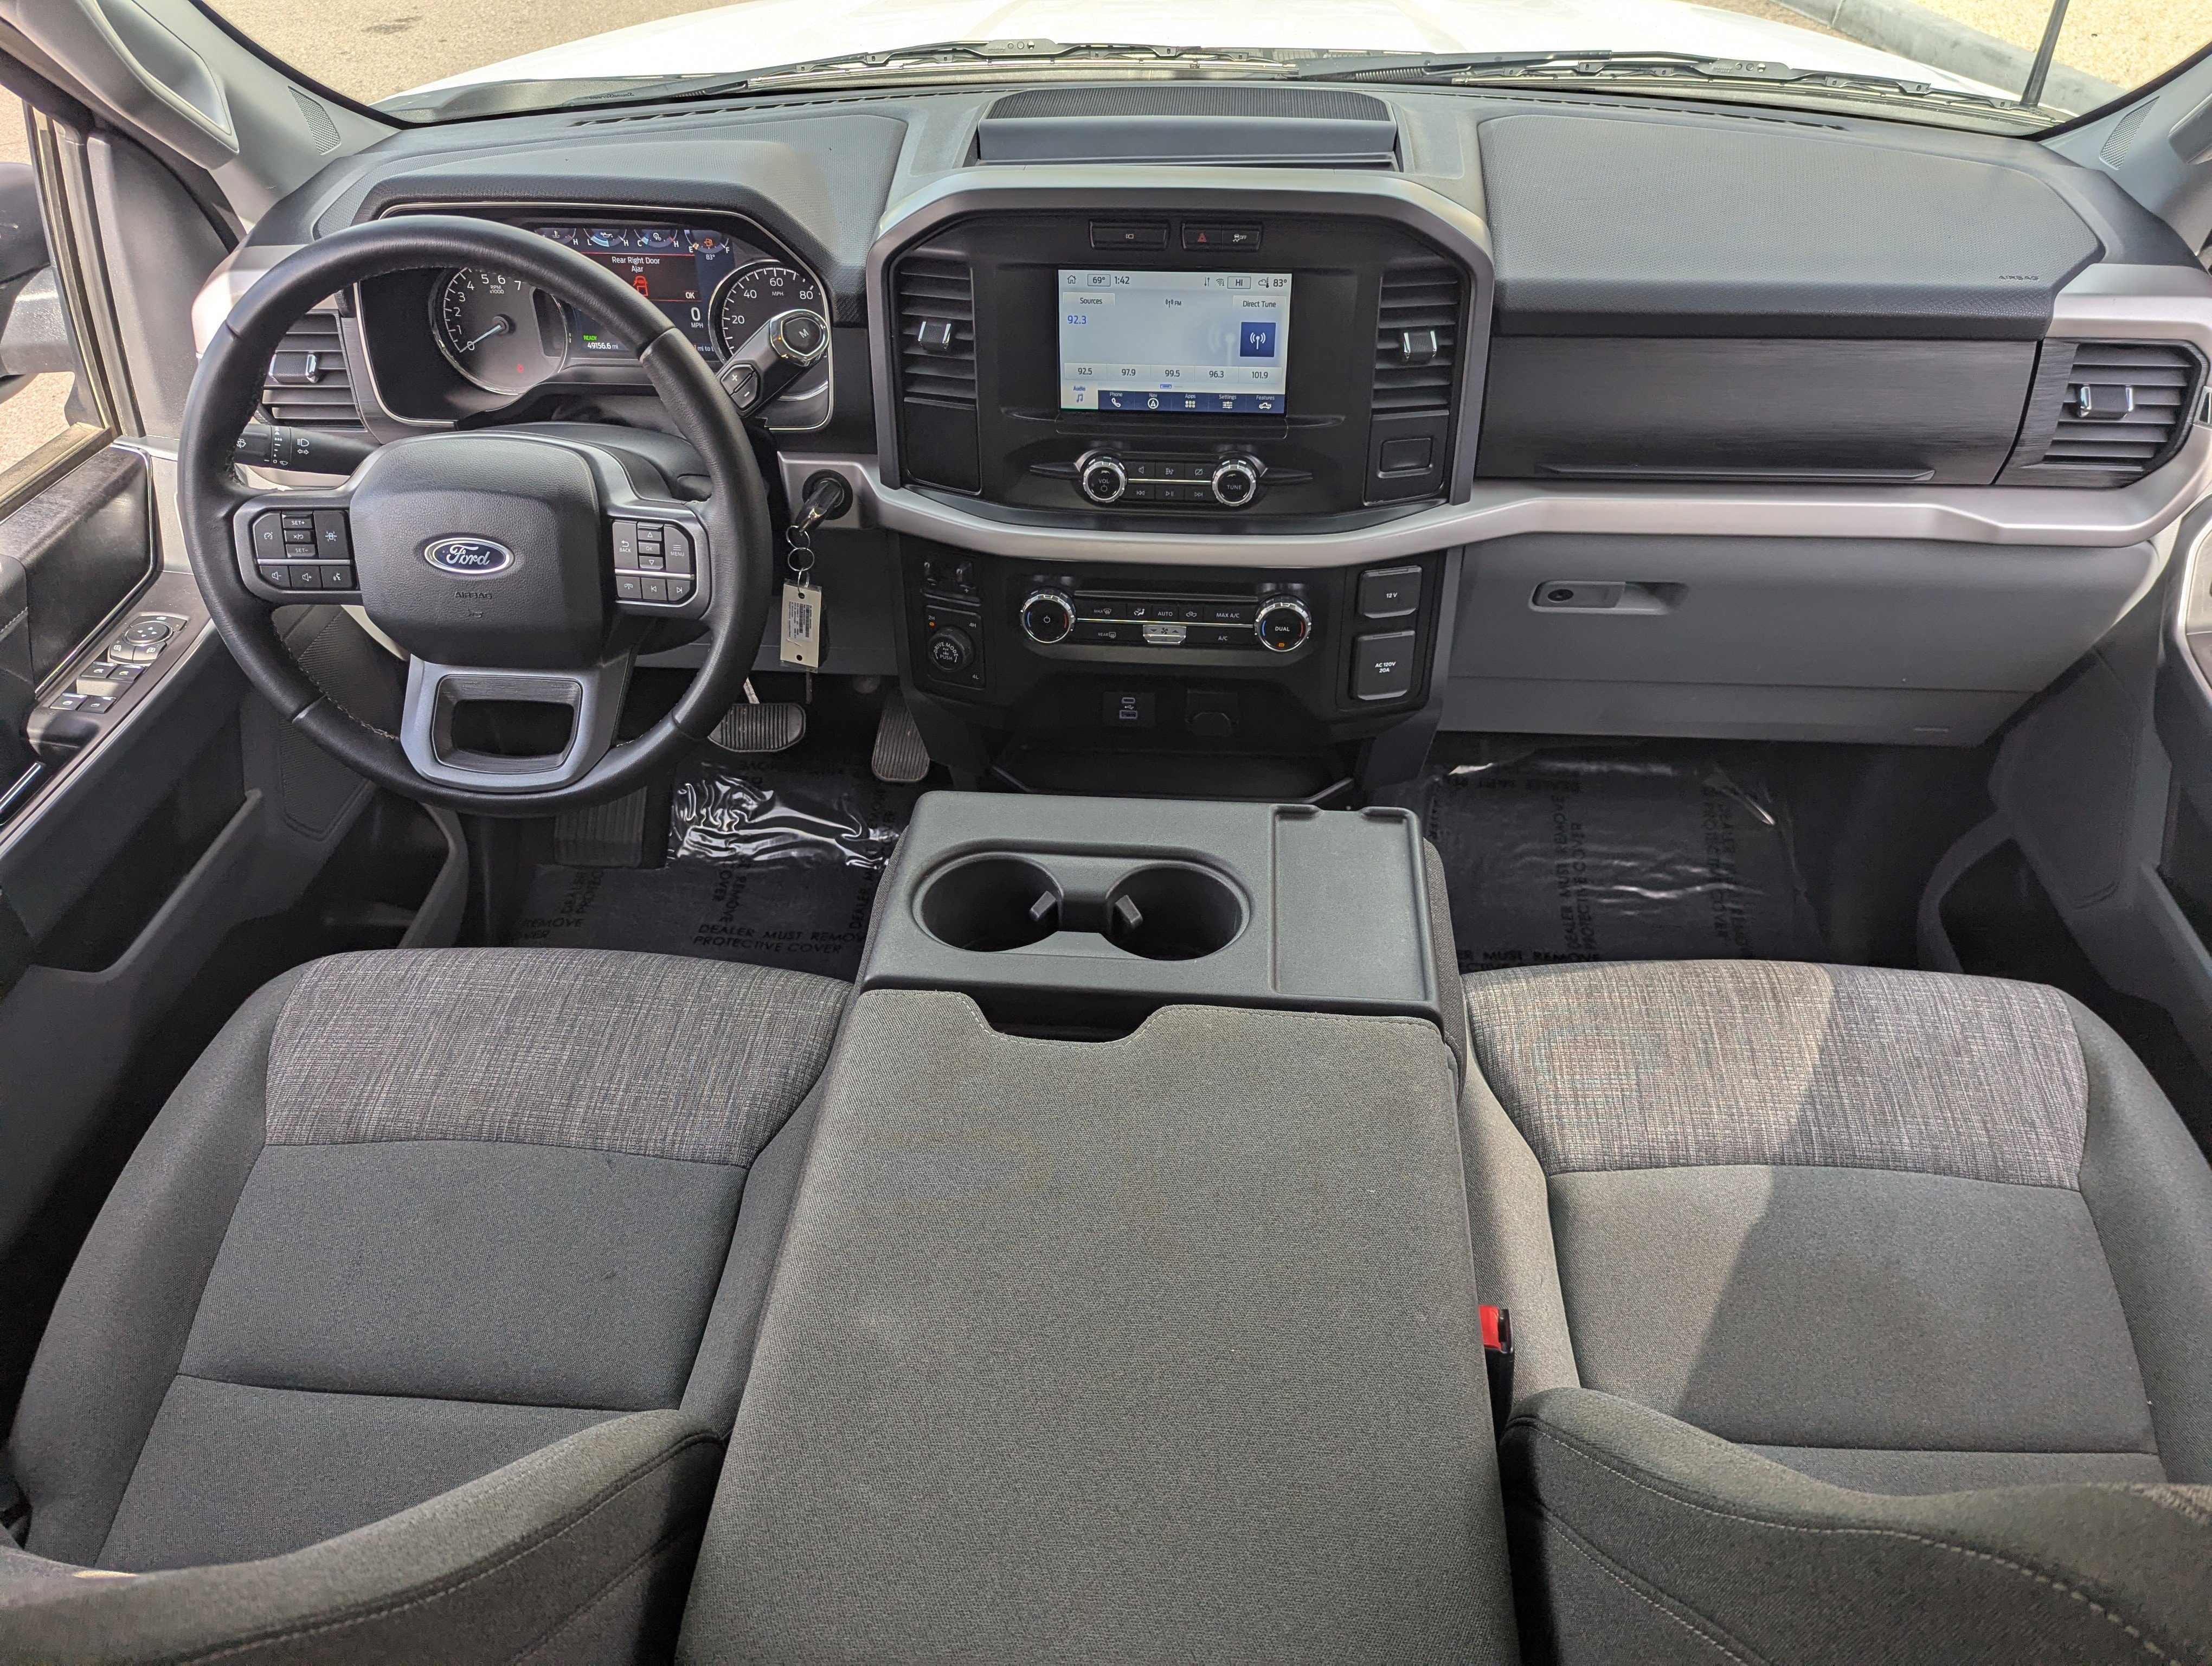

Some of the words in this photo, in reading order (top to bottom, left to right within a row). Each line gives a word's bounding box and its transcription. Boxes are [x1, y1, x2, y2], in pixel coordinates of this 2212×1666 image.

[628, 257, 644, 265] Right
[631, 265, 644, 273] Ajar
[481, 274, 488, 284] 5
[497, 274, 505, 284] 6
[769, 277, 783, 286] 60
[1273, 279, 1287, 287] 83°
[467, 281, 475, 291] 4
[515, 280, 522, 291] 7
[458, 292, 466, 302] 3
[743, 290, 757, 298] 40
[800, 290, 813, 299] 80
[454, 307, 461, 317] 2
[691, 307, 701, 322] 0
[731, 315, 744, 324] 20
[1068, 315, 1086, 324] 92.3
[799, 329, 809, 338] M
[467, 341, 475, 351] 0
[446, 544, 491, 566] Ford
[454, 591, 493, 599] AIRBAG
[934, 642, 944, 653] DRIVE
[946, 642, 959, 657] MODE
[698, 924, 755, 938] DEALER
[762, 931, 803, 941] MUST
[811, 932, 866, 943] REMOV
[692, 935, 781, 952] PROTECTIVE
[787, 943, 843, 953] COVER
